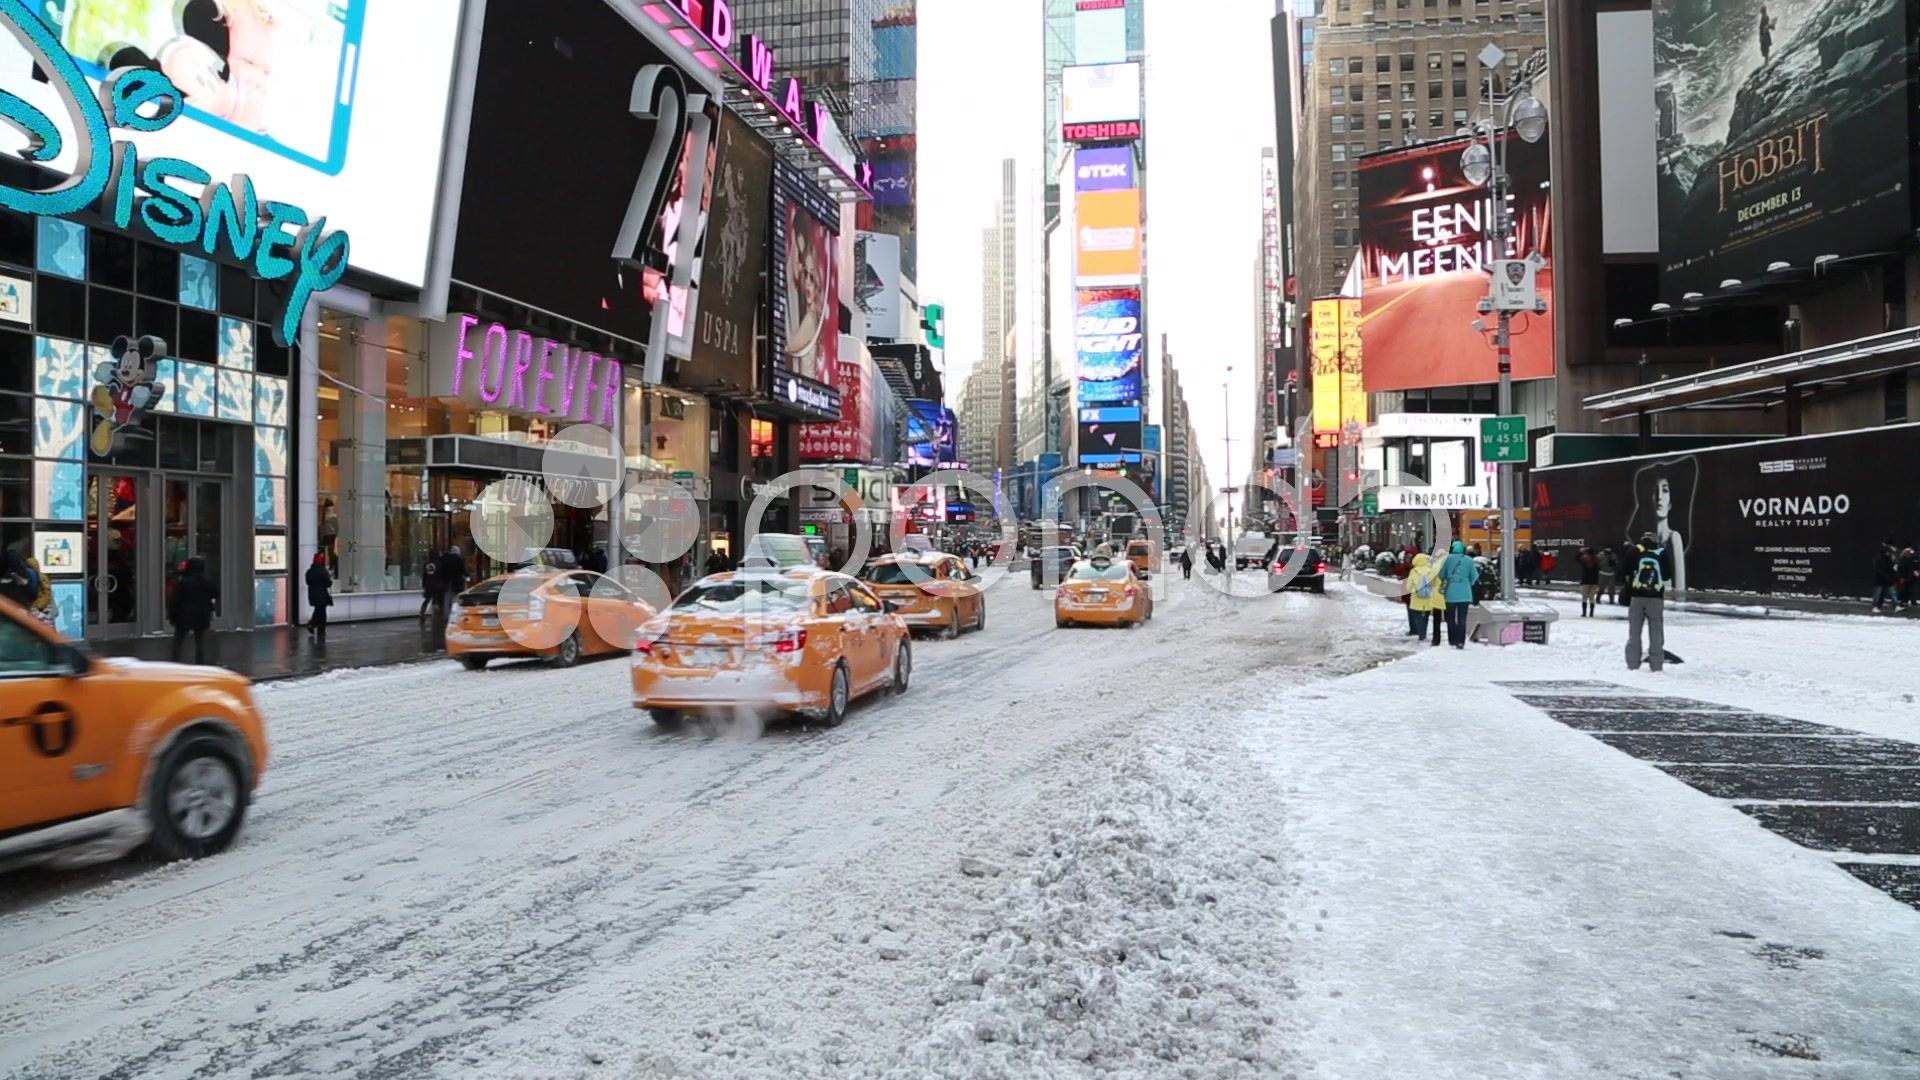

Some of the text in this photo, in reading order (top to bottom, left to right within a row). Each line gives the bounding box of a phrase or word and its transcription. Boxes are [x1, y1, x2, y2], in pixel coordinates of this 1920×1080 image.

[1064, 122, 1139, 139] TOSHIBA
[1092, 163, 1127, 178] TDK
[1717, 112, 1829, 212] HOBBIT
[1737, 192, 1789, 223] DECEMBER
[1791, 186, 1802, 202] 13
[702, 310, 740, 355] USPA
[1077, 316, 1138, 335] BUD
[1076, 333, 1143, 353] IGHT
[453, 313, 622, 428] FOREVER
[1081, 408, 1100, 422] FX
[1483, 433, 1524, 444] W 45 St
[1739, 494, 1849, 517] VORNADO
[1755, 518, 1832, 528] REALTY TRUST
